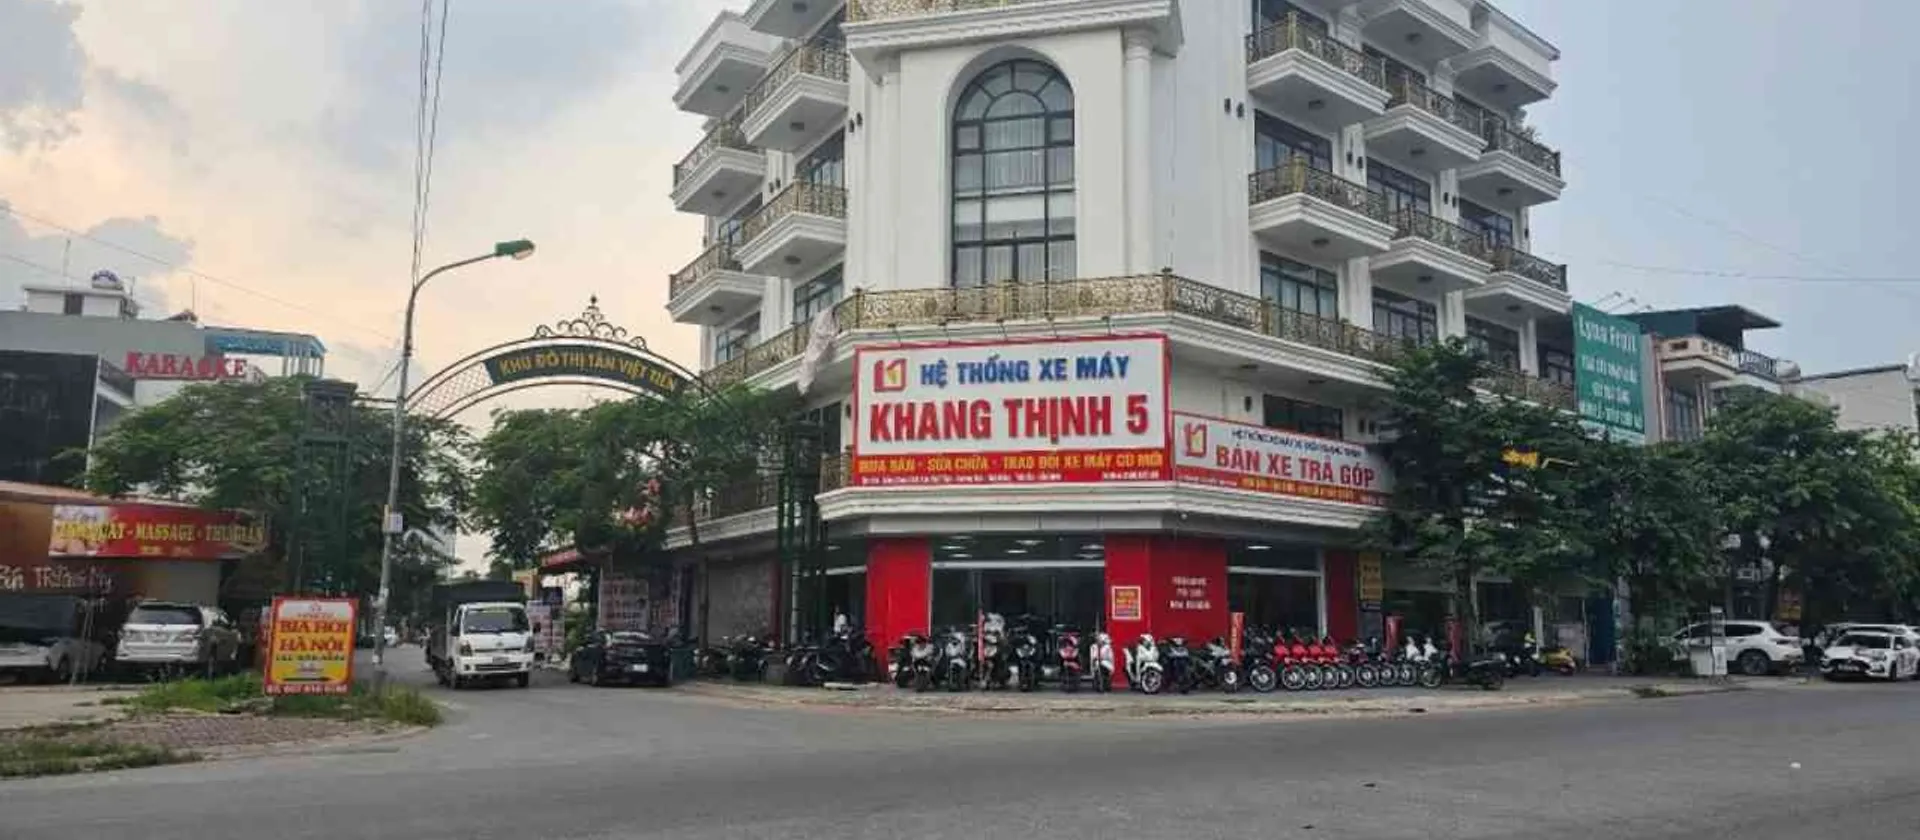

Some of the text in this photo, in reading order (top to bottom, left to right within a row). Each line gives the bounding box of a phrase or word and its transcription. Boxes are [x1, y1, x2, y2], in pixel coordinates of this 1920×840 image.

[125, 351, 246, 376] KARAOKE
[501, 356, 532, 376] KHU
[920, 351, 1130, 388] HỆ THỐNG XE MÁY
[869, 394, 1149, 444] KHANG THỊNH 5
[1216, 443, 1260, 473] BÁN
[1268, 453, 1293, 477] XE
[1299, 455, 1334, 483] TRẢ
[1340, 462, 1375, 488] GÓP
[136, 521, 194, 542] MASSAGE
